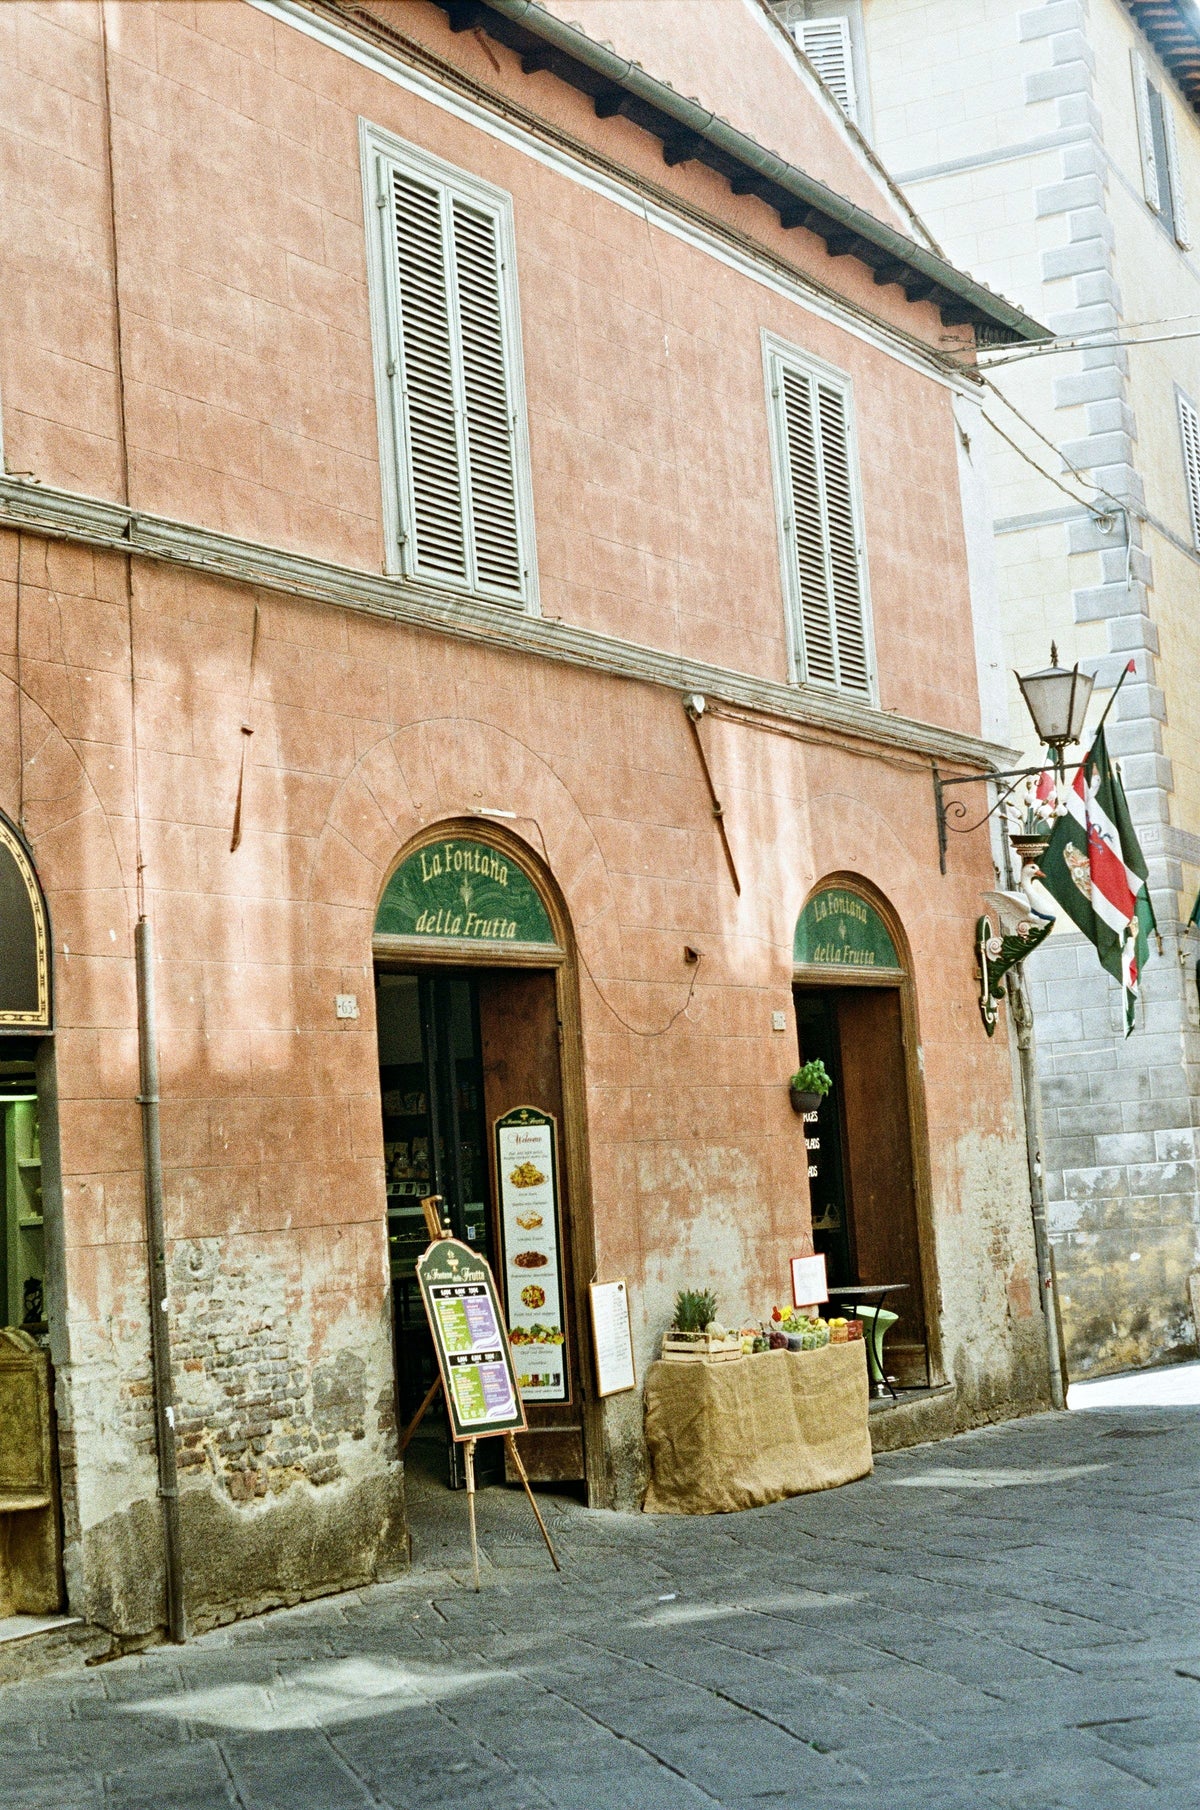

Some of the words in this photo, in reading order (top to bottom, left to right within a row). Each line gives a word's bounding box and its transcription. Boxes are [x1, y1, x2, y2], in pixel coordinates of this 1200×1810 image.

[420, 852, 442, 882] La
[445, 843, 508, 887] Fontana
[814, 900, 827, 923] La
[828, 892, 867, 924] Fontana
[415, 909, 461, 935] della
[463, 911, 517, 938] Frutta
[814, 943, 841, 962] della
[843, 945, 875, 965] Frutta
[461, 1267, 486, 1283] Frutta
